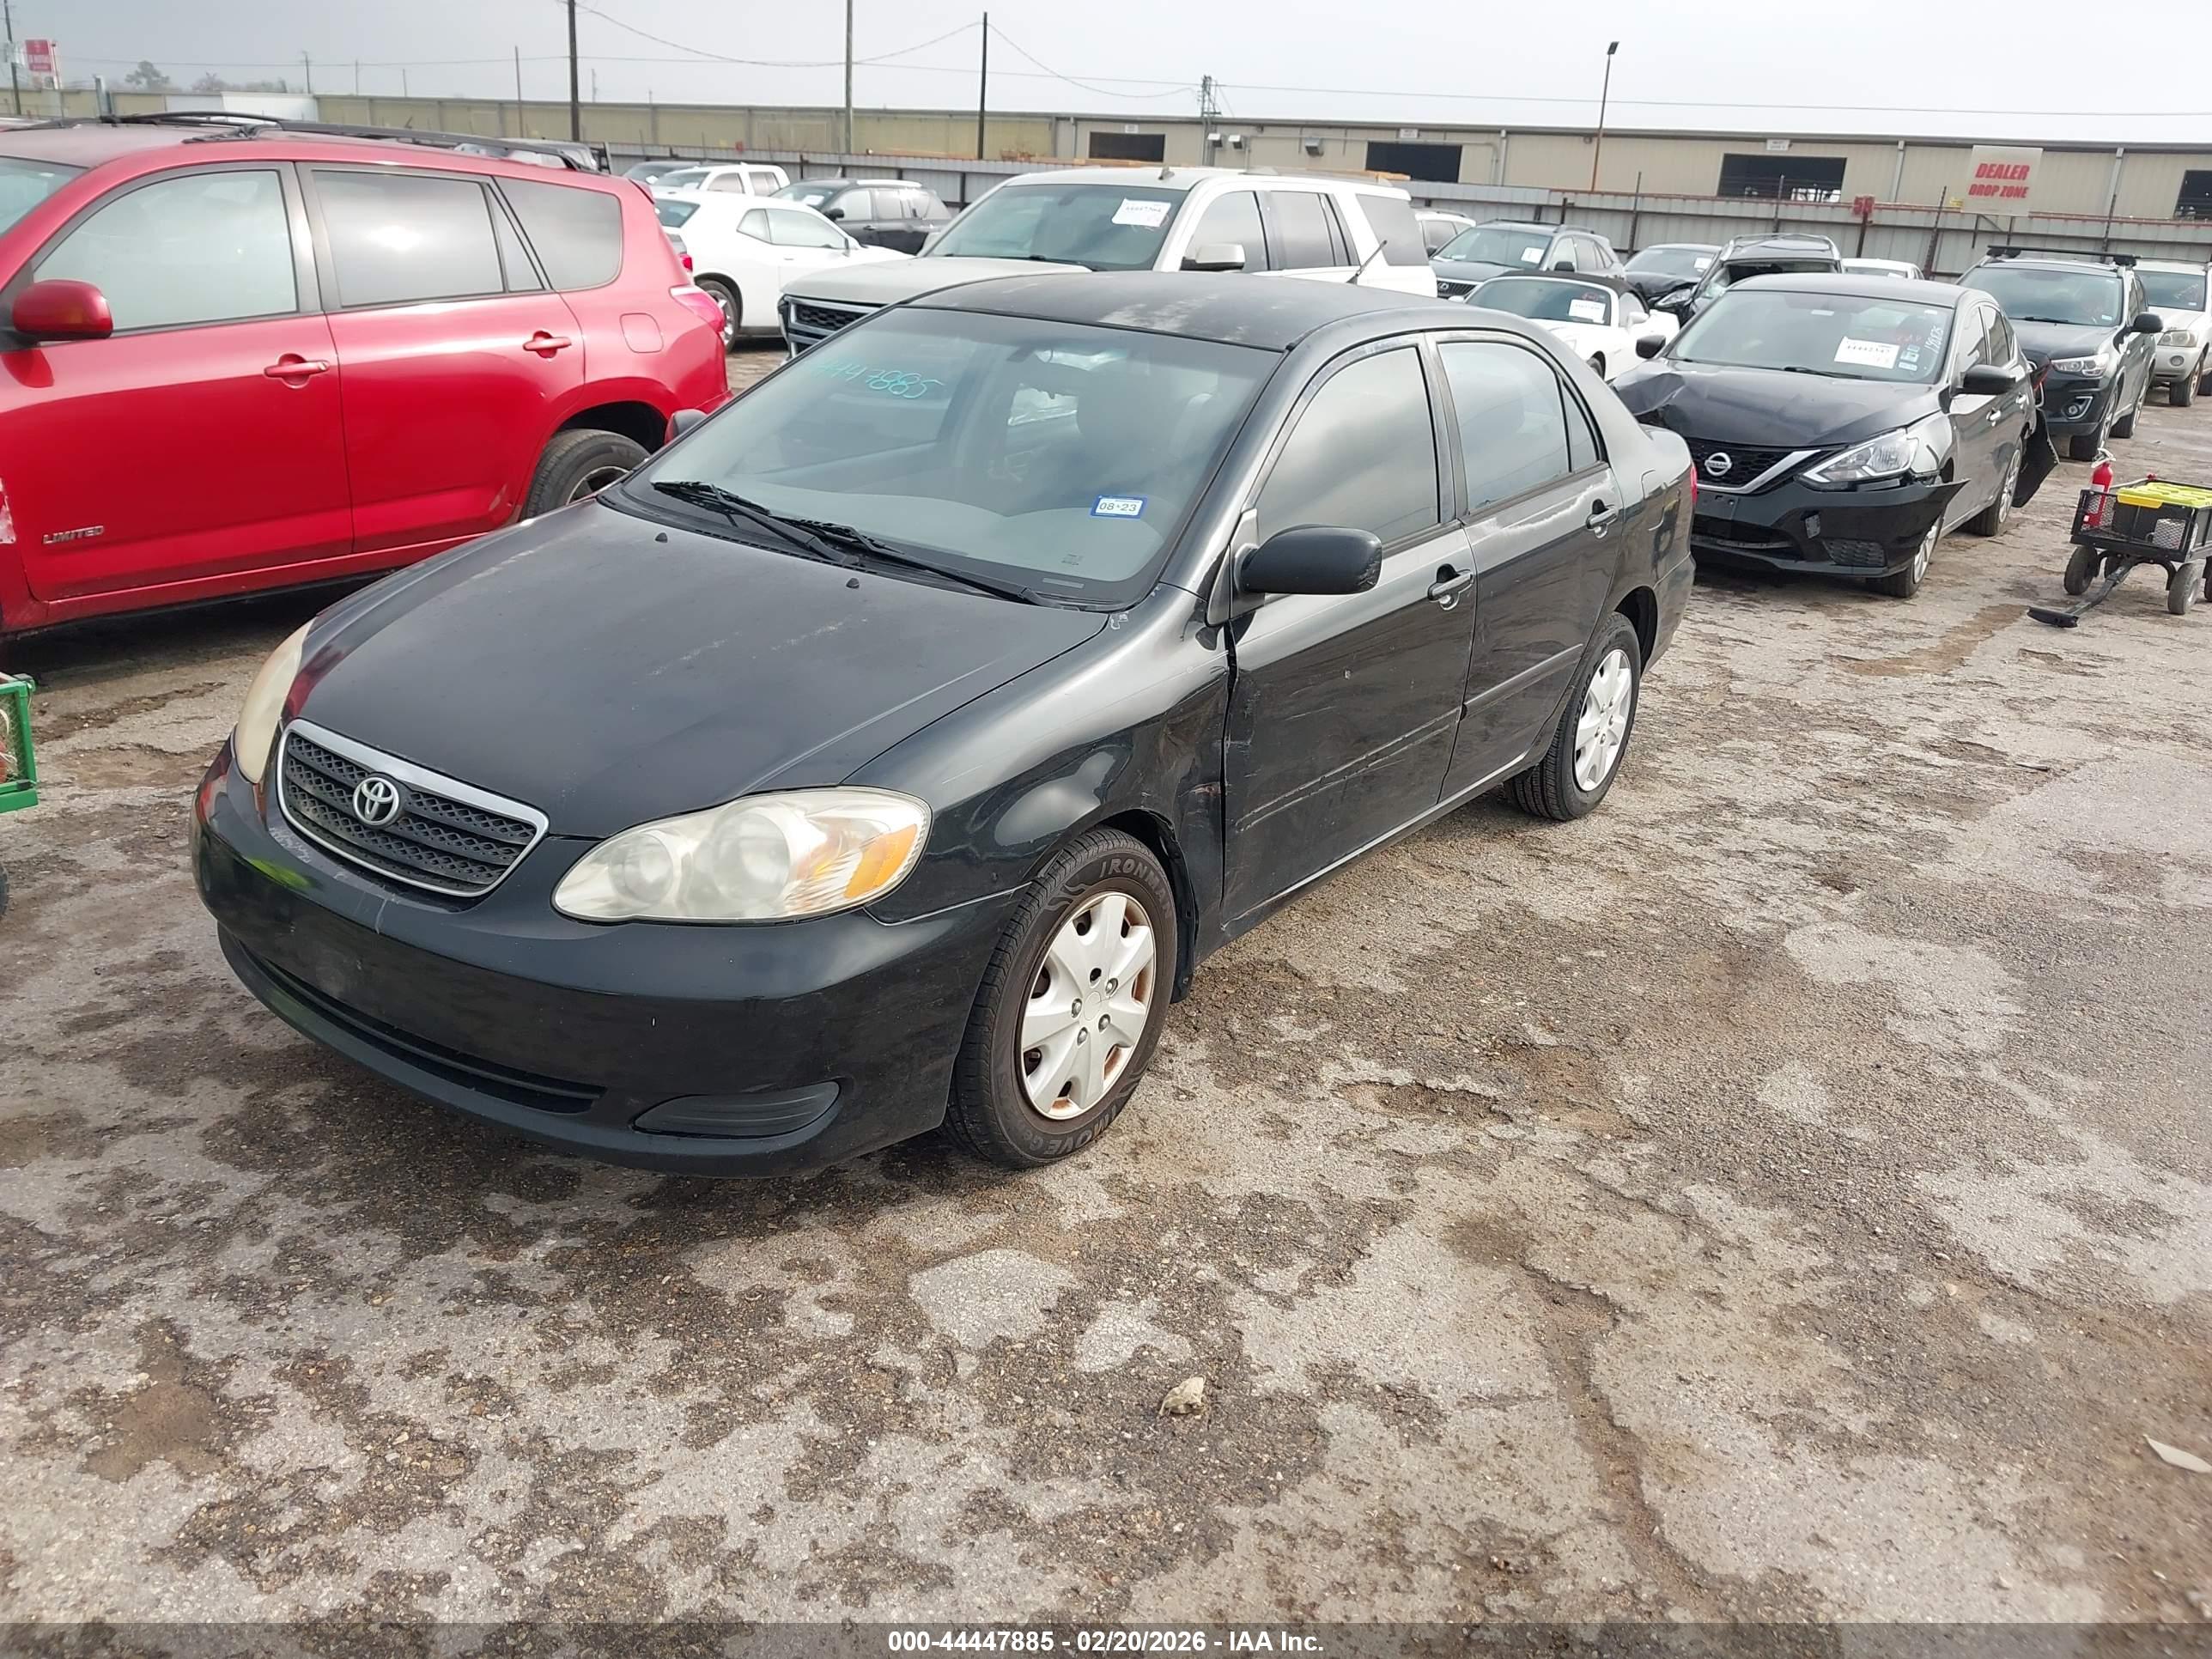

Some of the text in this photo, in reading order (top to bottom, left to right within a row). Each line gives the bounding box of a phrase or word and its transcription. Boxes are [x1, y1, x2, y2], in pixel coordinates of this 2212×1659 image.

[1975, 163, 2030, 180] DEALER
[1968, 184, 2029, 198] DROP ZONE
[43, 526, 104, 544] LIMITED
[1099, 859, 1174, 919] IRONMAN
